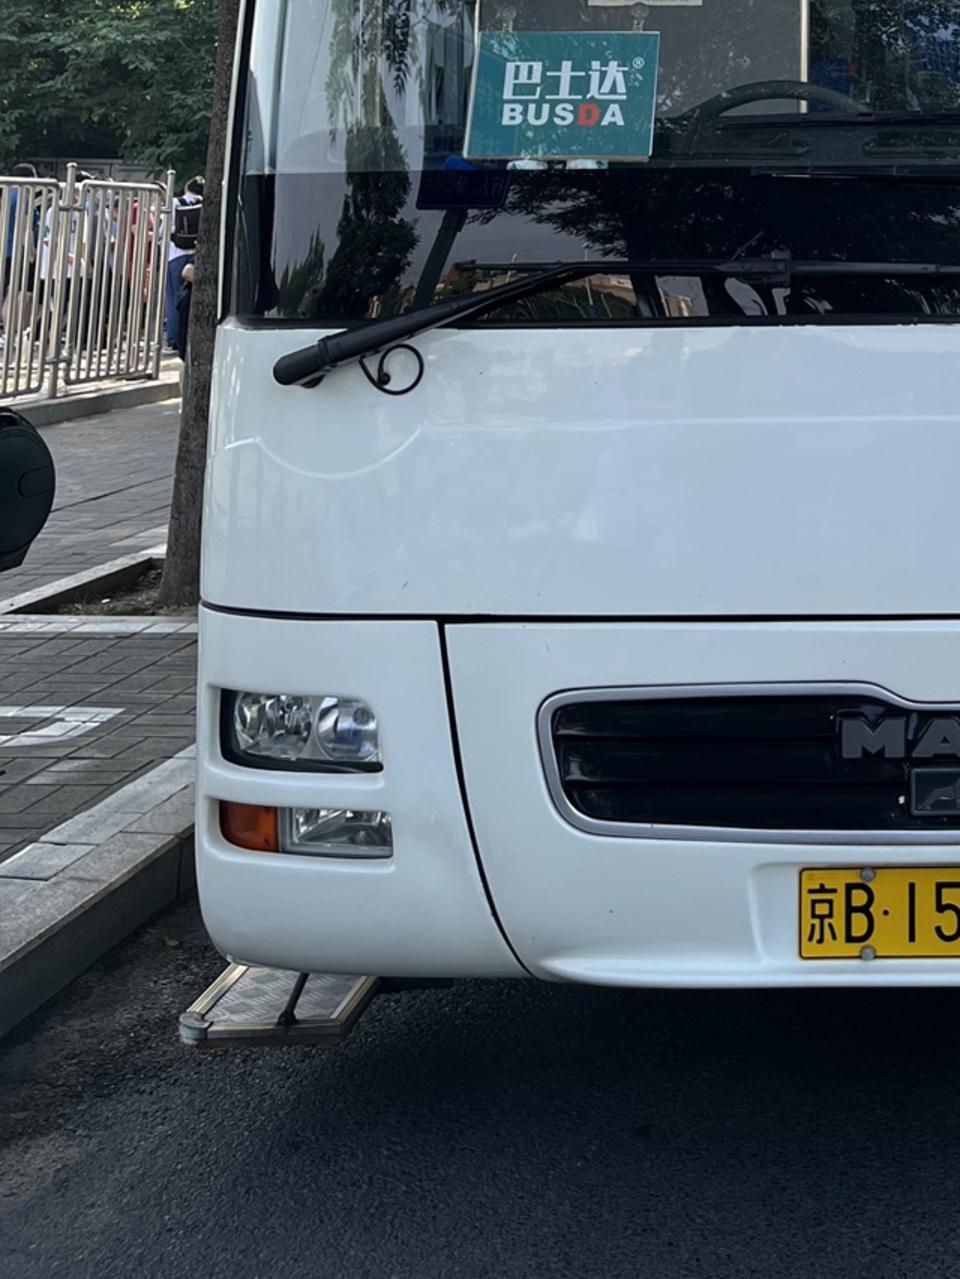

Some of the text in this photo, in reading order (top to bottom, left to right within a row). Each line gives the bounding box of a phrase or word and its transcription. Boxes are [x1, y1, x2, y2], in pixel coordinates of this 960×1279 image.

[503, 60, 628, 100] 巴士达
[501, 103, 625, 126] BUSDA
